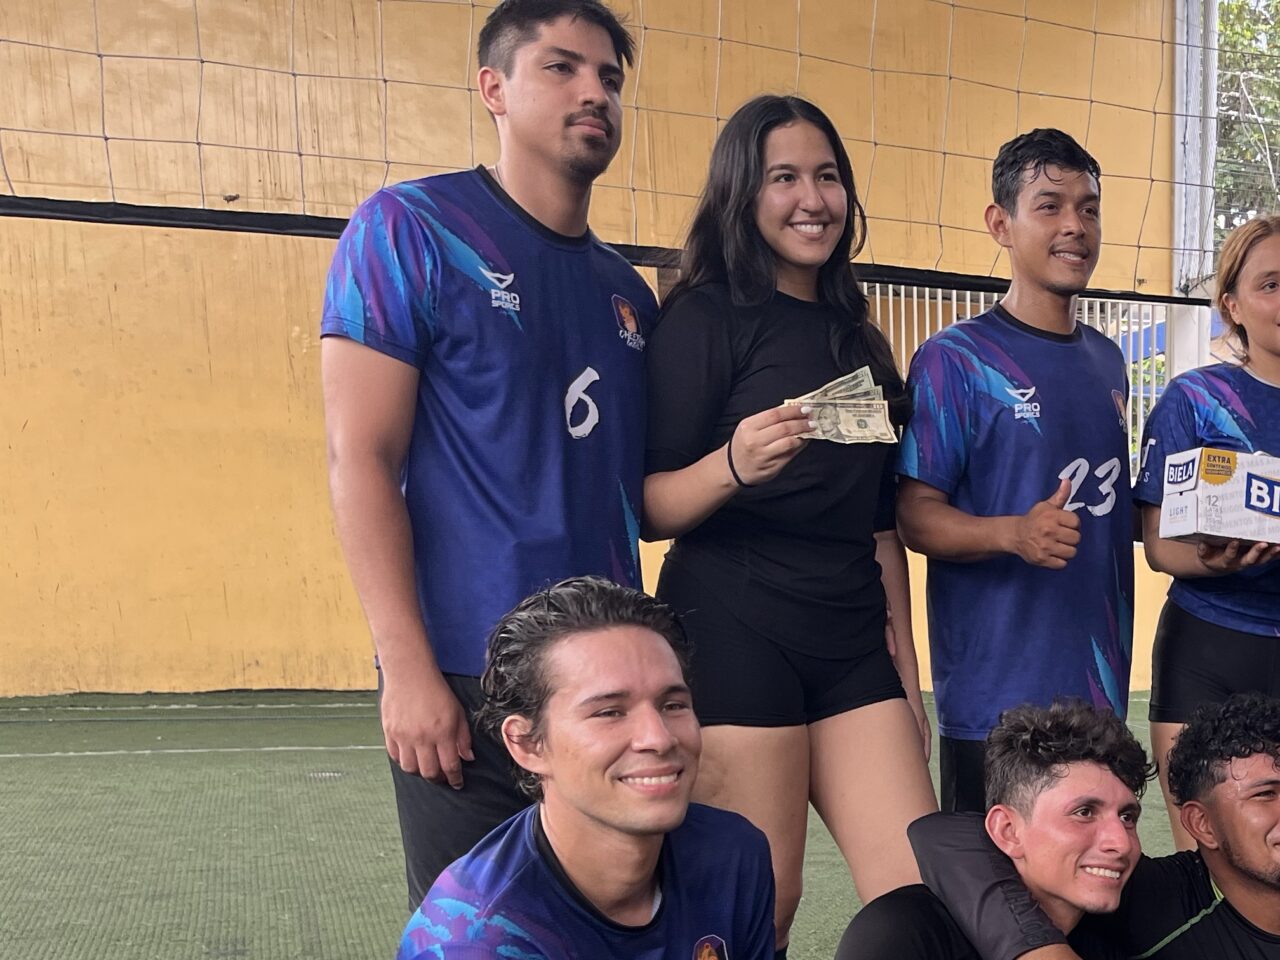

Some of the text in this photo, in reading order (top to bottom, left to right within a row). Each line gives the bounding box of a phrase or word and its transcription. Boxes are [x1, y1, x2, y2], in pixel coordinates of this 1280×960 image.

[491, 289, 520, 304] PRO
[565, 367, 600, 439] 6
[1014, 402, 1041, 412] PRO
[1208, 454, 1231, 465] EXTRA
[1168, 461, 1194, 483] BIELA
[1058, 457, 1121, 516] 23
[1206, 494, 1220, 507] 12
[1169, 505, 1189, 517] LIGHT
